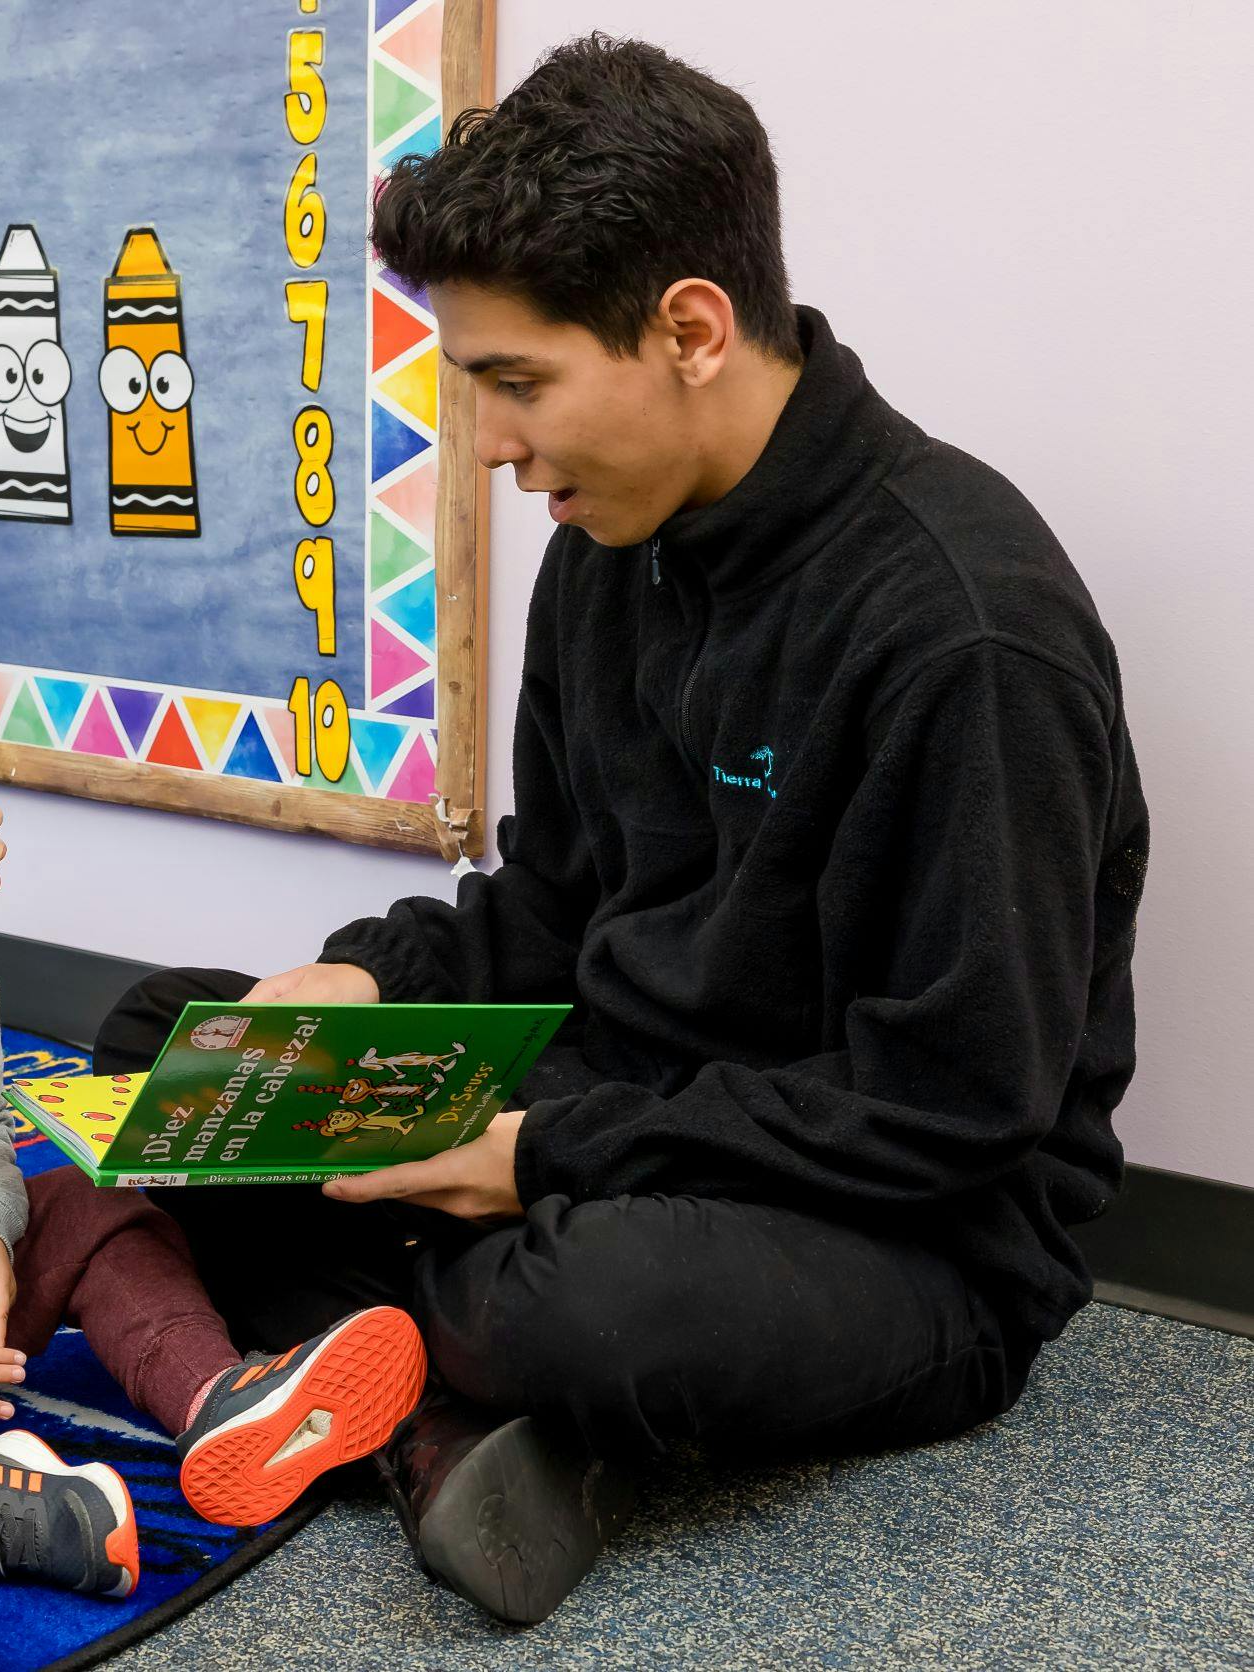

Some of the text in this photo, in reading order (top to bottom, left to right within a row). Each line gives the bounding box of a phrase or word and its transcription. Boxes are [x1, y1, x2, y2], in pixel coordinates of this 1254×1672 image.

[283, 30, 327, 145] 5
[283, 152, 326, 269] 6
[284, 280, 328, 393] 7
[293, 404, 335, 527] 8
[293, 537, 336, 657] 9
[288, 676, 351, 783] 10
[141, 1105, 195, 1163] ¡Diez
[183, 1047, 266, 1163] manzanas
[219, 1015, 323, 1162] en la cabeza!
[435, 1103, 466, 1124] Dr.
[236, 1174, 293, 1183] manzanas
[310, 1172, 321, 1181] la
